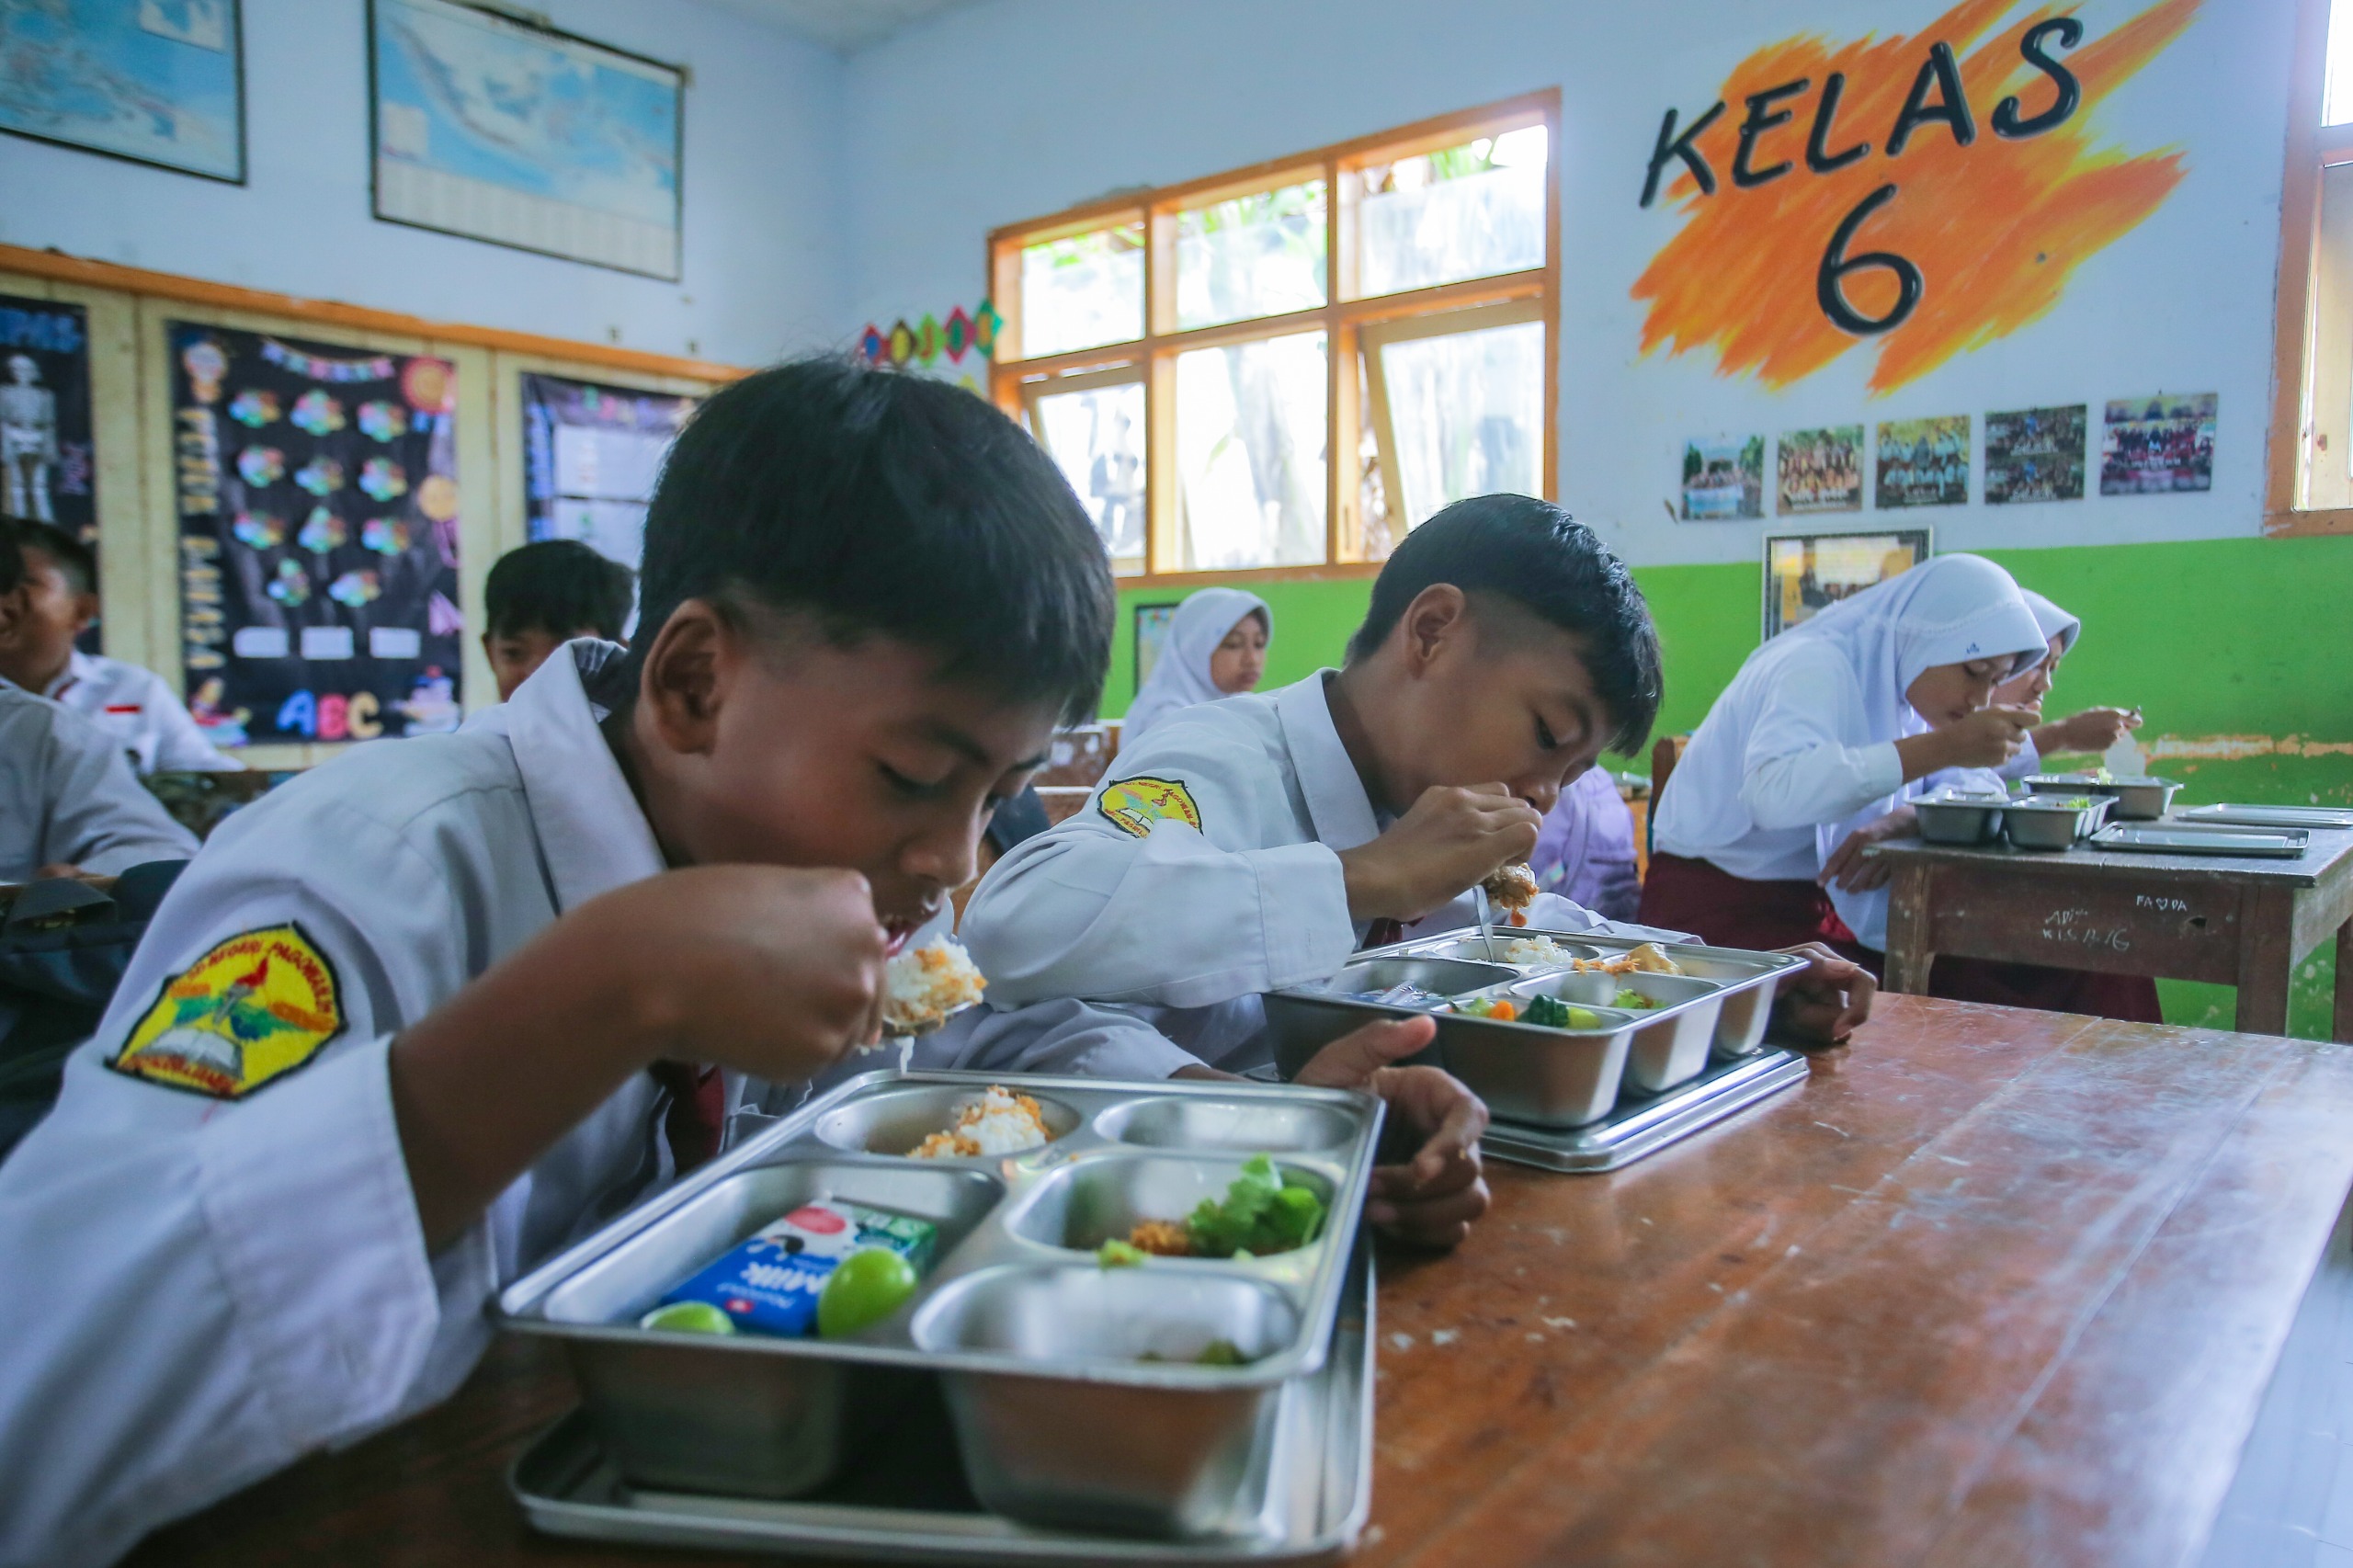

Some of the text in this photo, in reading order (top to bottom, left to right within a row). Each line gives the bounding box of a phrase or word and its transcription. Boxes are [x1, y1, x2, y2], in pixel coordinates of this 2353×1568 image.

[1639, 17, 2084, 208] KELAS
[1816, 183, 1924, 336] 6
[276, 688, 384, 740] ABC
